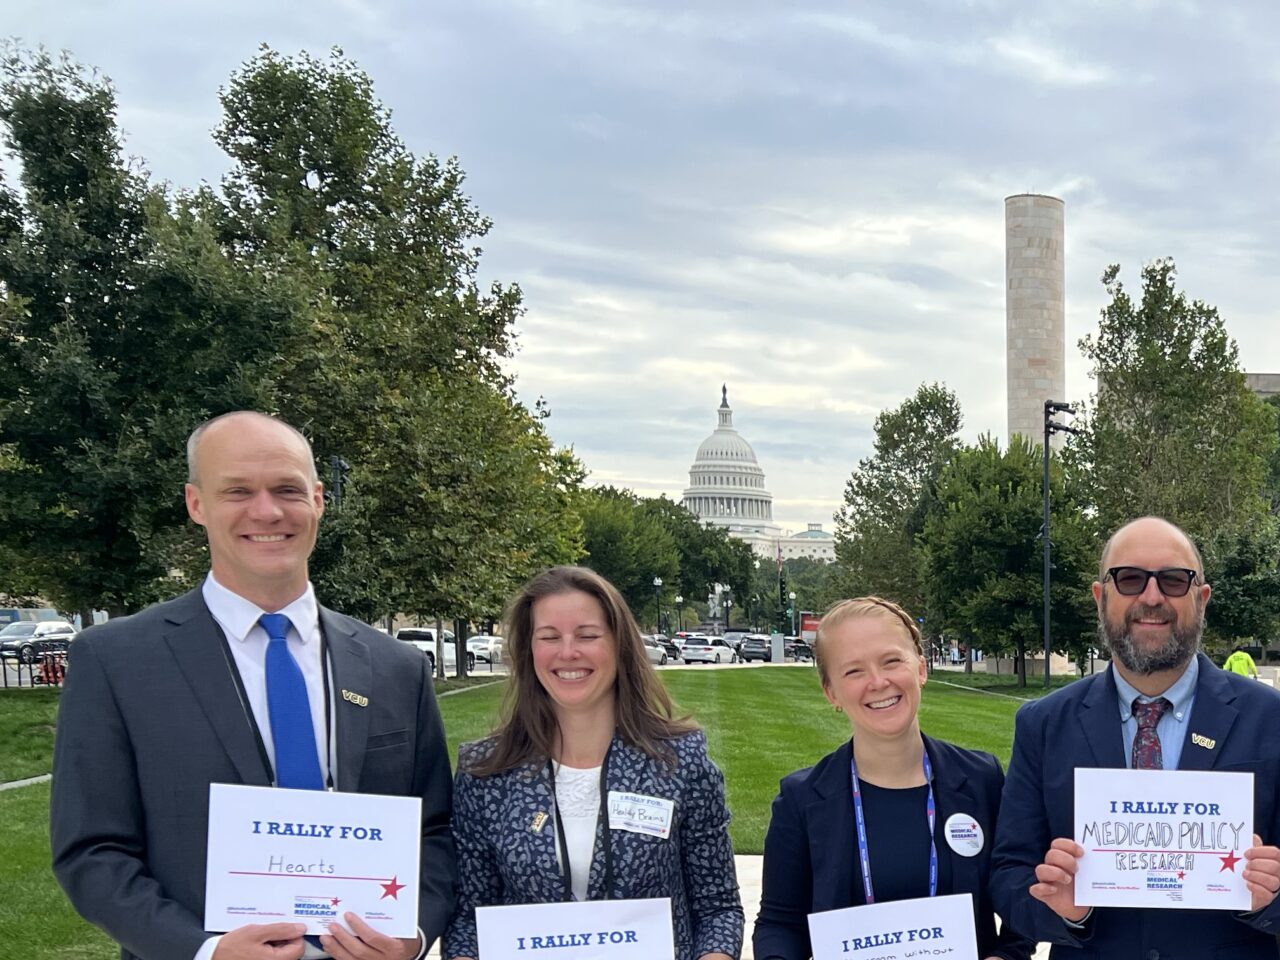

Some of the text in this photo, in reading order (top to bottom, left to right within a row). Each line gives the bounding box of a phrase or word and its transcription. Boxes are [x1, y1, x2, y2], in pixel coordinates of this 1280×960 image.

[342, 690, 368, 706] VCU
[1192, 733, 1216, 749] VCU
[1110, 801, 1220, 816] I RALLY FOR
[252, 820, 383, 841] I RALLY FOR
[1082, 821, 1245, 850] MEDICAID POLICY
[268, 856, 335, 874] Hearts
[1116, 852, 1194, 870] RESEARCH
[294, 902, 331, 910] MEDICAL
[294, 908, 338, 916] RESEARCH
[517, 930, 638, 950] I RALLY FOR
[842, 926, 944, 952] I RALLY FOR
